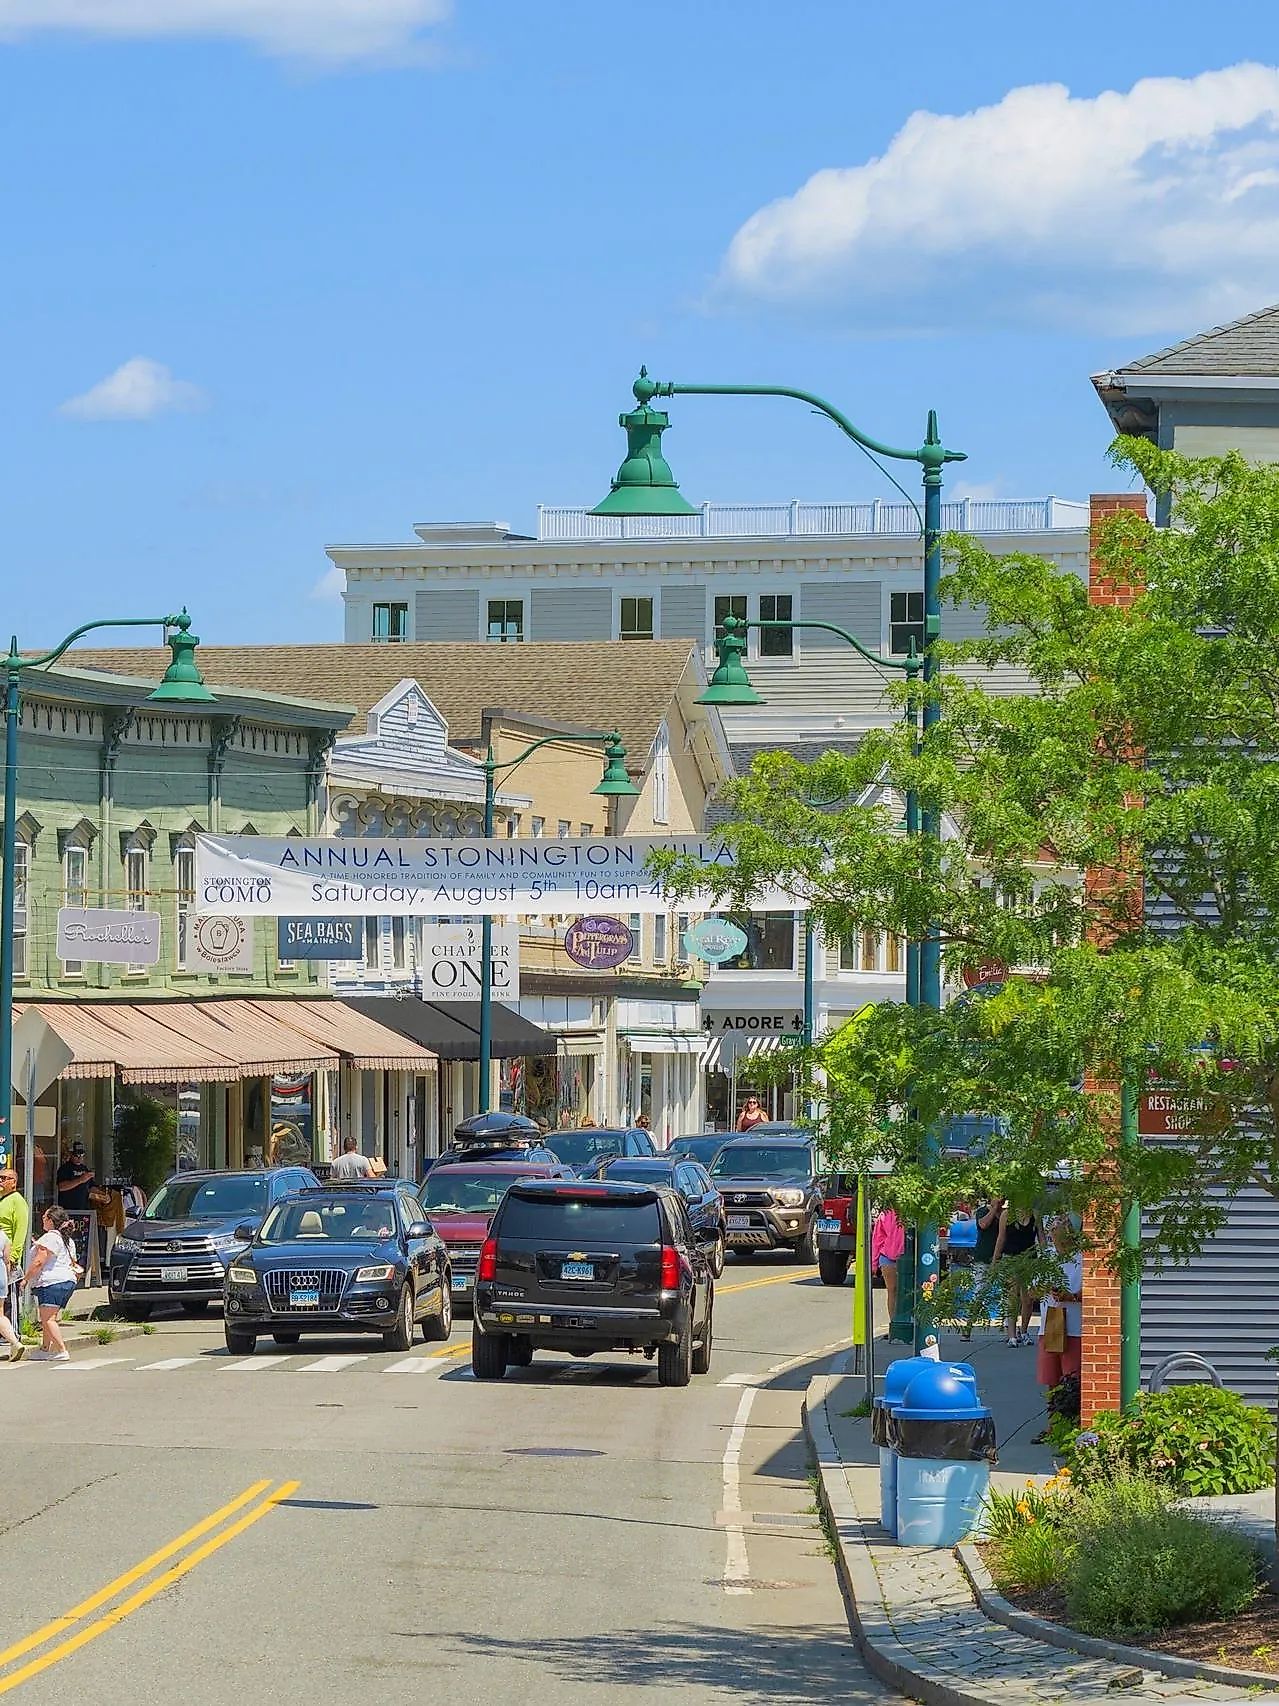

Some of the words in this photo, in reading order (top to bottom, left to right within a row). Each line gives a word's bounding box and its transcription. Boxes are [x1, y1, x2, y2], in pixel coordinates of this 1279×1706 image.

[279, 847, 410, 867] ANNUAL
[424, 844, 634, 867] STONINGTON
[203, 876, 272, 886] STONINGTON
[353, 872, 398, 880] HONORED
[401, 871, 447, 880] TRADITION
[450, 871, 463, 880] OF
[465, 871, 496, 880] FAMILY
[499, 871, 519, 879] AND
[522, 871, 577, 880] COMMUNITY
[580, 870, 597, 878] FUN
[600, 870, 612, 878] TO
[614, 869, 652, 878] SUPPOR
[203, 885, 272, 903] COMO
[311, 883, 425, 906] Saturday,
[433, 882, 517, 906] August
[529, 879, 557, 901] 5th
[64, 922, 153, 945] Rochelle's
[287, 922, 313, 944] SEA
[317, 922, 353, 944] BAGS
[431, 945, 510, 957] CHAPER
[431, 960, 511, 988] ONE
[722, 1015, 785, 1030] ADORE
[1165, 1115, 1194, 1130] SHOP
[497, 1289, 525, 1298] TAHOE
